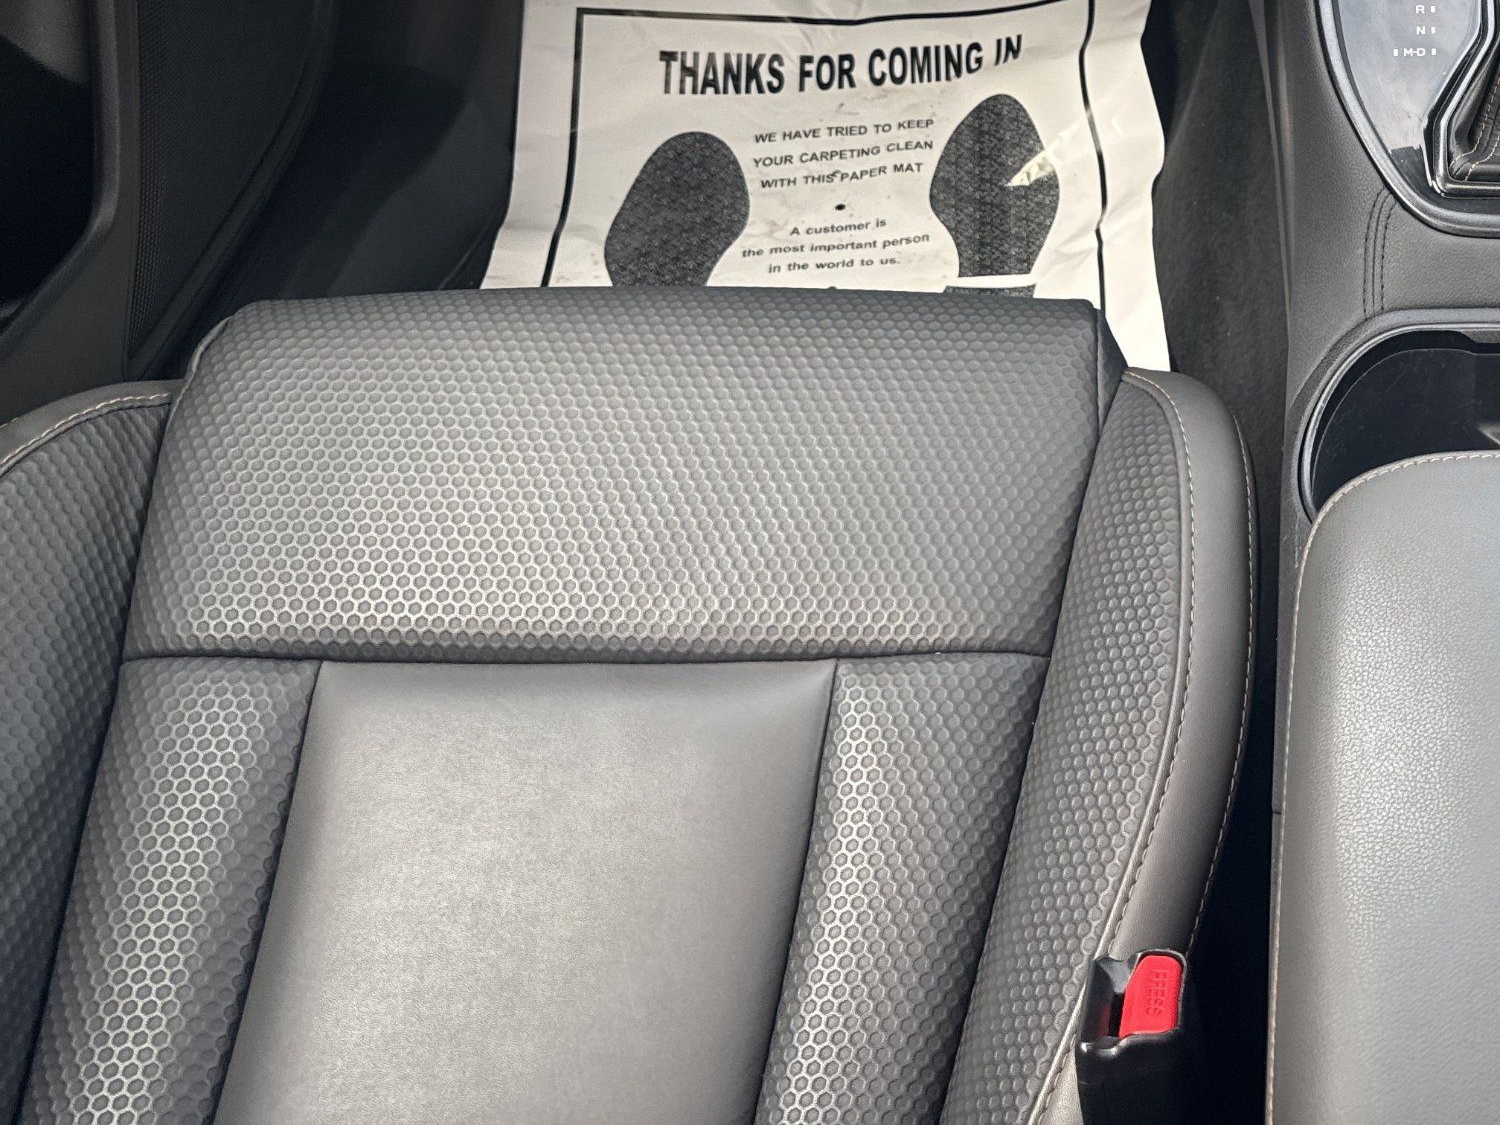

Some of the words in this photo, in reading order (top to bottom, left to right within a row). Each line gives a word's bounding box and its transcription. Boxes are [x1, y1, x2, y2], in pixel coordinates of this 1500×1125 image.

[1415, 4, 1425, 14] R
[1416, 25, 1426, 35] N
[659, 50, 785, 95] THANKS
[798, 54, 856, 92] FOR
[868, 41, 984, 86] COMING
[993, 33, 1023, 66] IN
[754, 131, 777, 144] WE
[782, 127, 822, 142] HAVE
[826, 125, 868, 138] TRIED
[873, 122, 892, 134] TO
[898, 118, 935, 131] KEEP
[753, 153, 794, 168] YOUR
[799, 146, 881, 164] CARPETING
[886, 140, 934, 153] CLEAN
[760, 176, 797, 189] WITH
[803, 172, 834, 185] THIS
[840, 166, 888, 182] PAPER
[893, 162, 924, 173] MAT
[790, 227, 801, 236] A
[806, 221, 871, 235] customer
[875, 218, 887, 228] is
[742, 246, 764, 258] the
[769, 244, 805, 255] most
[810, 239, 878, 255] important
[882, 233, 930, 250] person
[768, 262, 782, 274] in
[787, 261, 810, 272] the
[815, 258, 855, 270] world
[860, 256, 874, 267] to
[879, 255, 901, 266] us.
